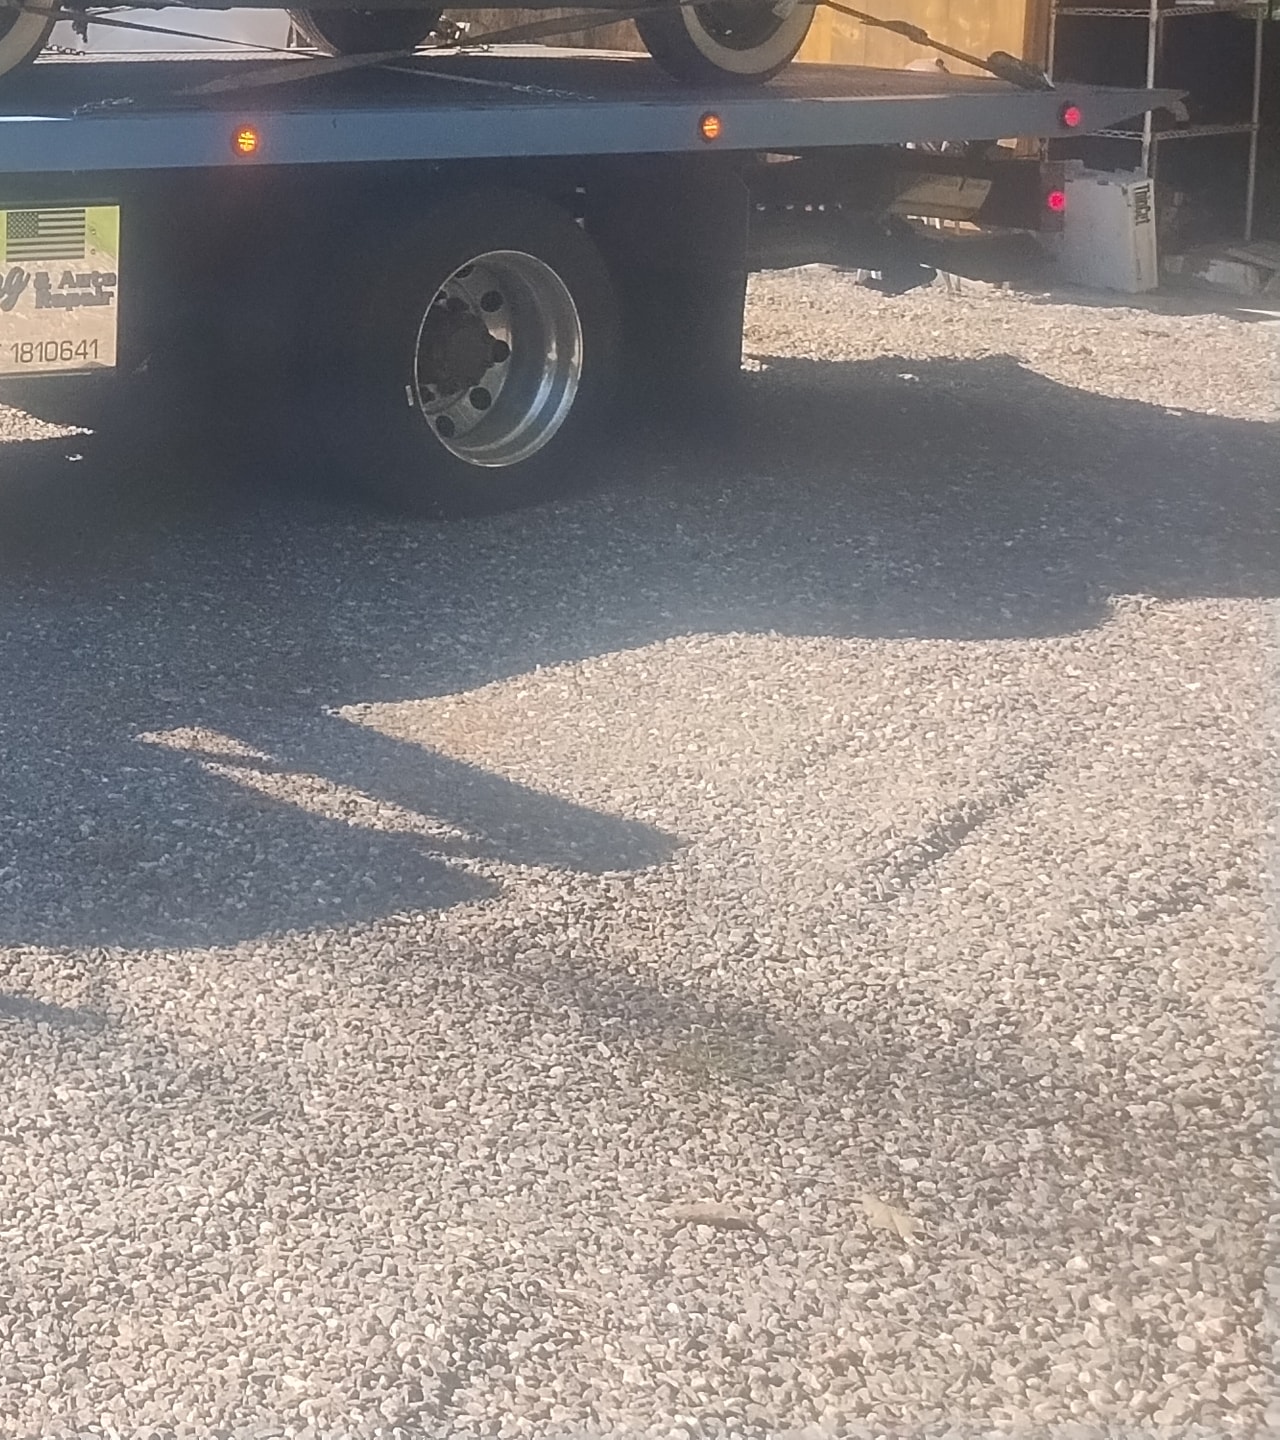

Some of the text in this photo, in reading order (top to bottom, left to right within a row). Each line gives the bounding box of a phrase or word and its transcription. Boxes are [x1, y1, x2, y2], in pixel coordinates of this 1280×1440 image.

[58, 271, 117, 289] Auto
[35, 291, 114, 312] Repair
[9, 339, 100, 363] 1810641
